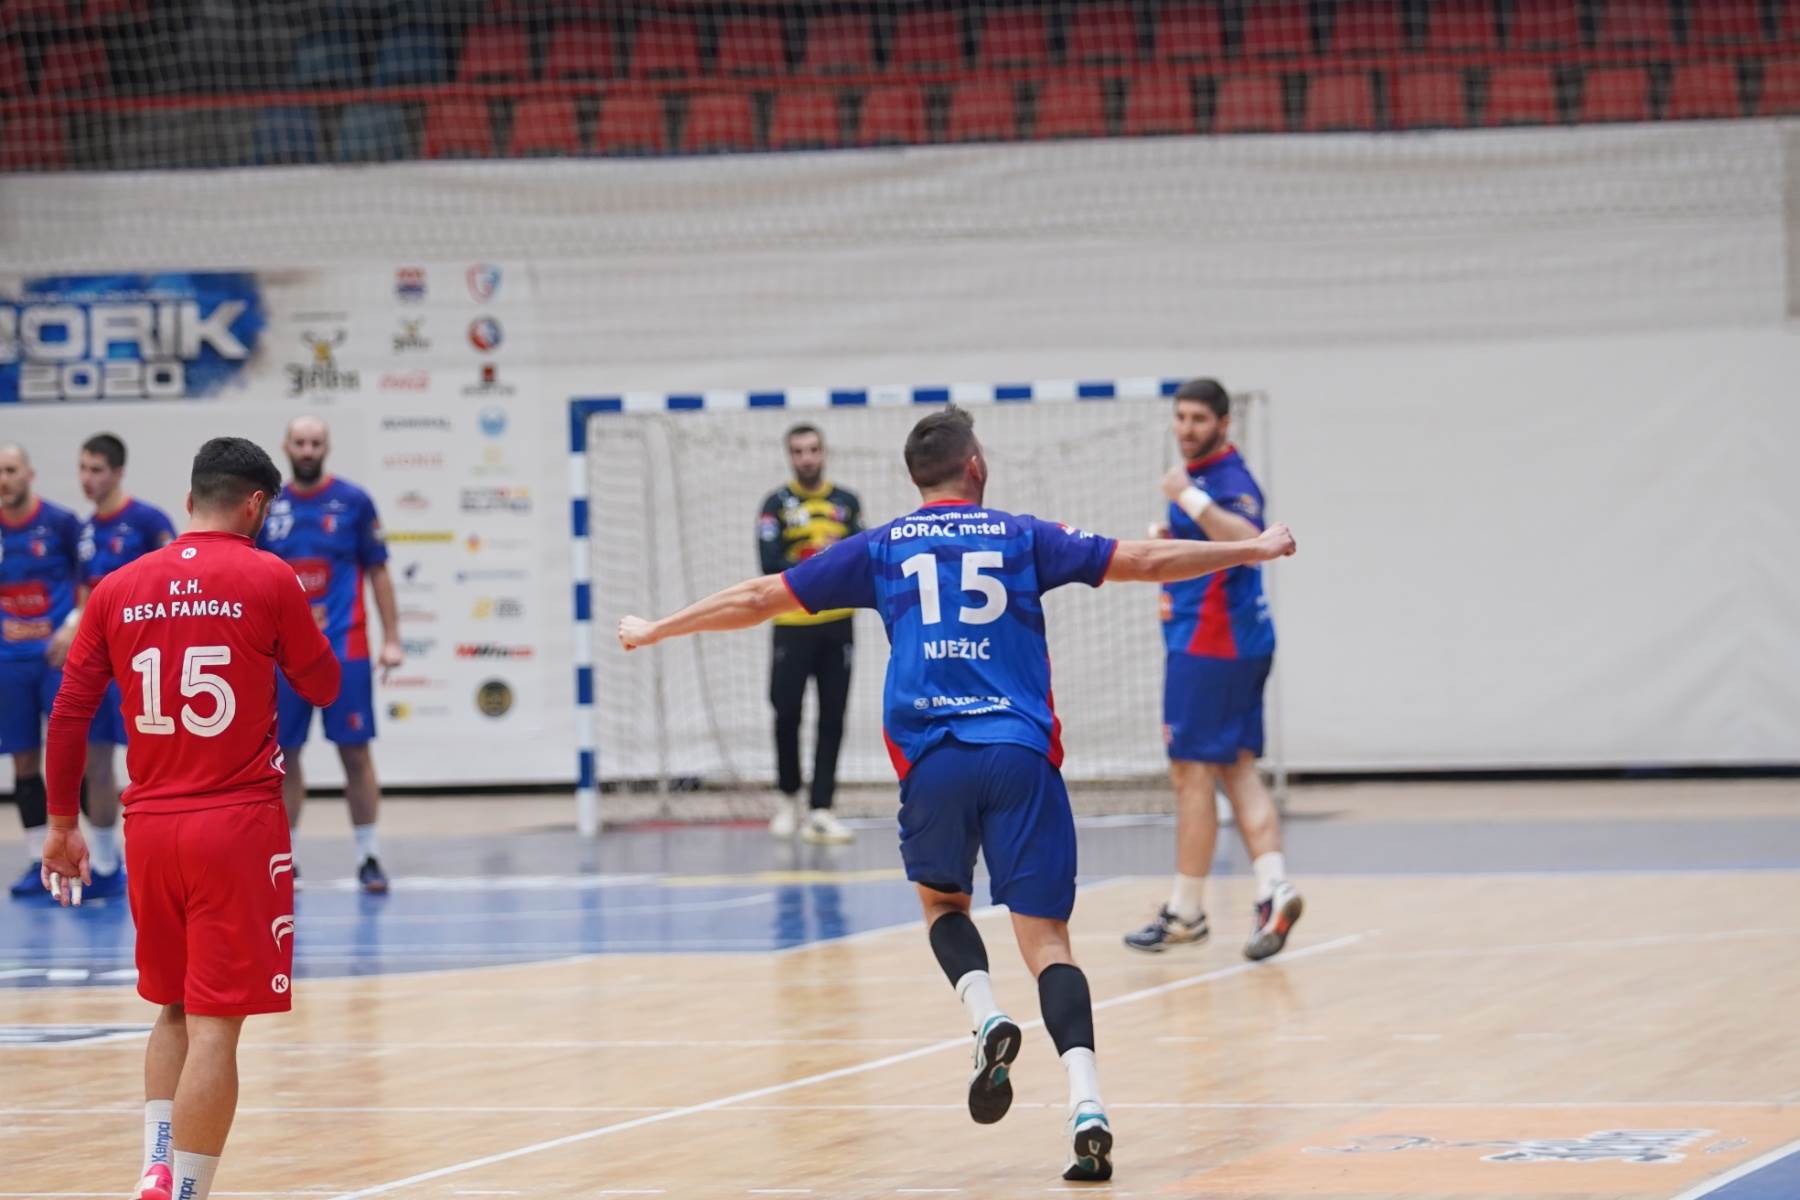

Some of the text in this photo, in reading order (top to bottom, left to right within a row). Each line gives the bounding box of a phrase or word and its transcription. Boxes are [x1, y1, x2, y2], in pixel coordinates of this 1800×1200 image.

[0, 300, 248, 361] ORIK
[19, 362, 185, 399] 2020
[890, 522, 1006, 540] BORAC m:tel
[169, 579, 203, 595] K.H.
[901, 551, 1008, 625] 15
[123, 600, 243, 623] BESA FAMGAS
[923, 637, 991, 660] NJEŽIĆ
[132, 645, 236, 737] 15
[152, 1121, 173, 1163] Kempa
